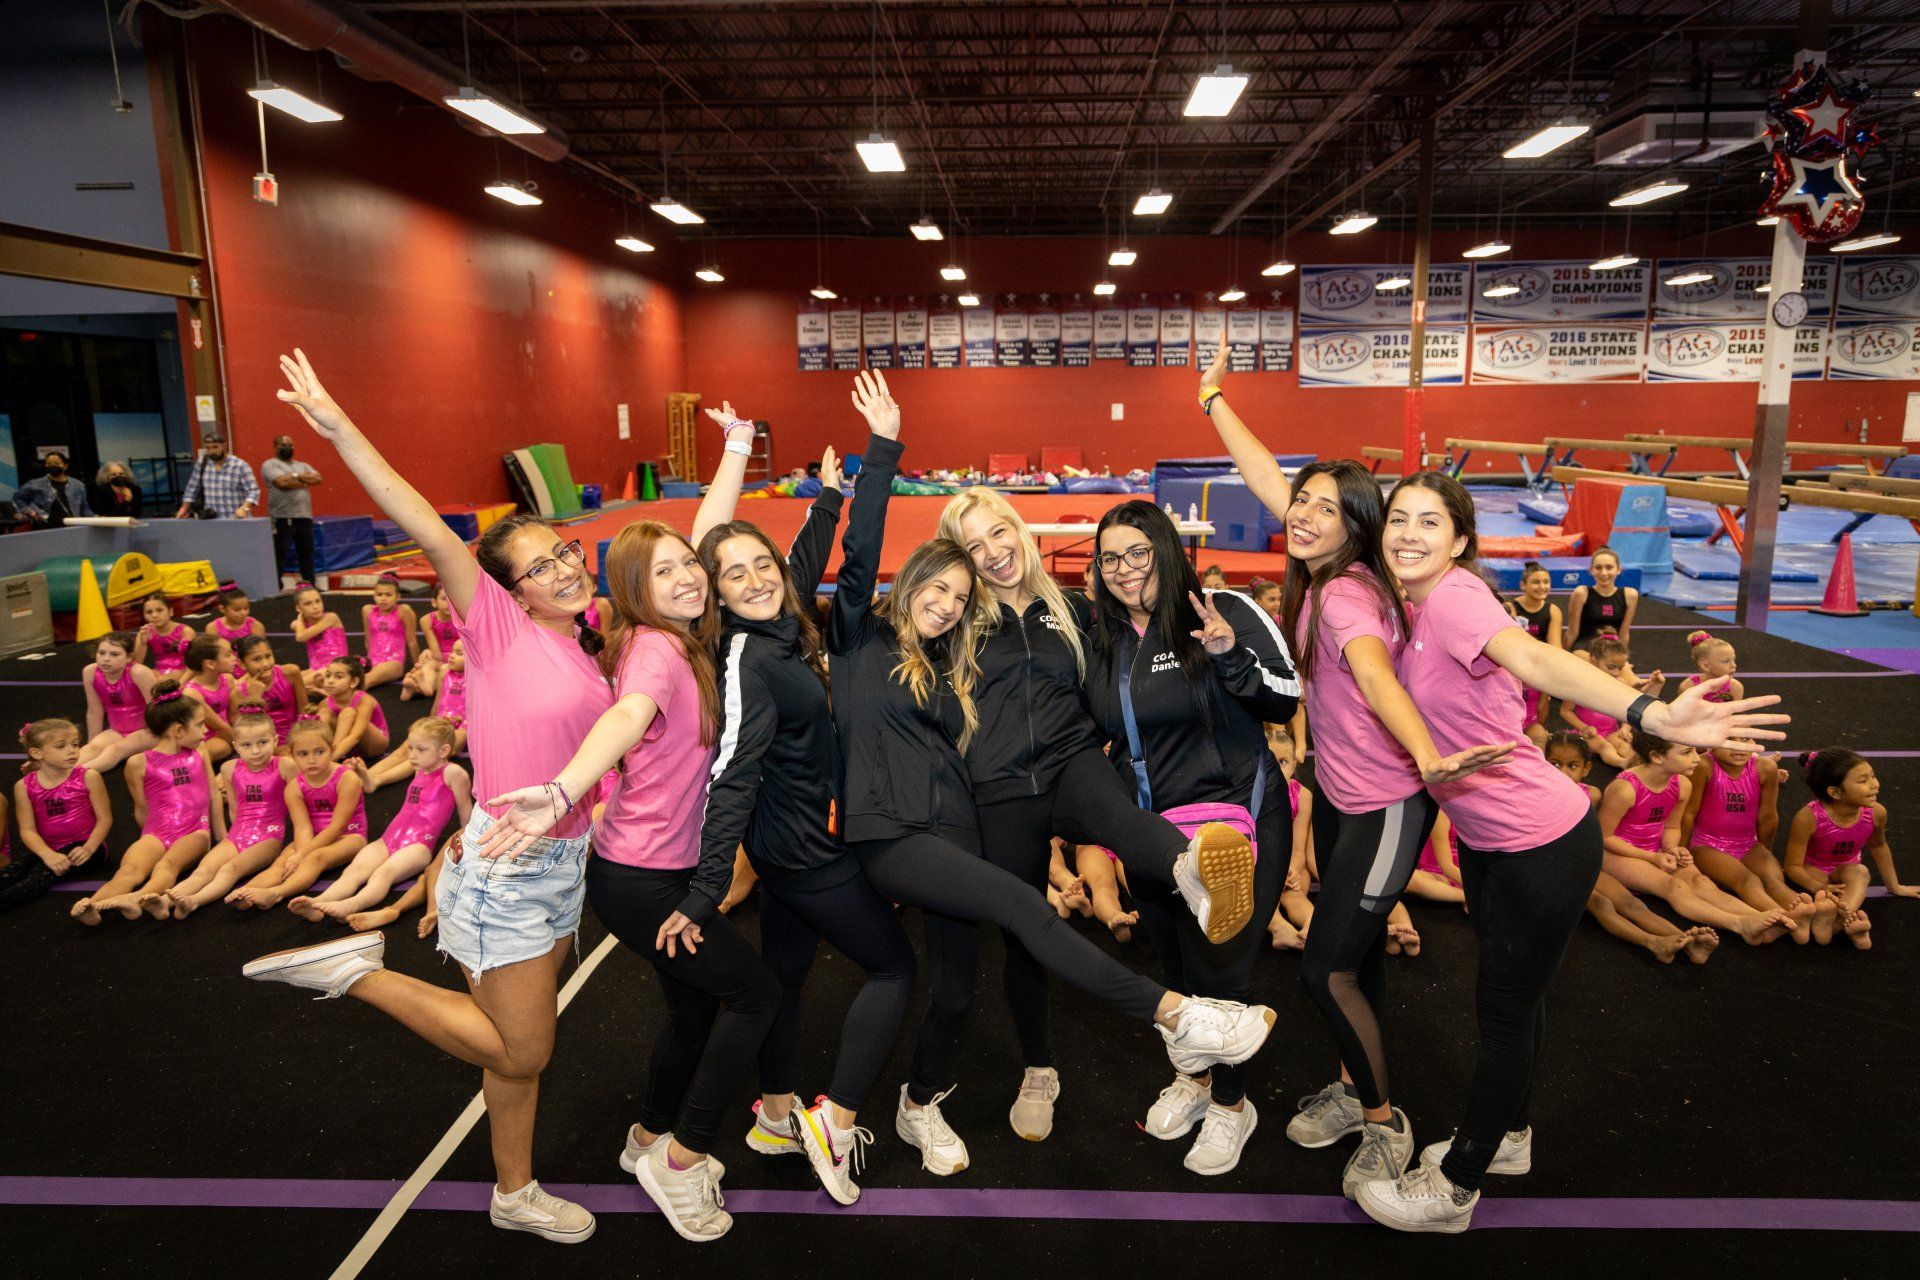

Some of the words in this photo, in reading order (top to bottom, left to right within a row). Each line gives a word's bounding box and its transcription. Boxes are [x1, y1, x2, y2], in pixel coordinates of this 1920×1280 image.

[1553, 268, 1590, 280] 2015
[1594, 268, 1643, 280] STATE
[1552, 282, 1643, 294] CHAMPIONS
[1869, 284, 1902, 295] USA
[1327, 294, 1358, 304] USA
[1570, 296, 1592, 304] Level
[1550, 331, 1586, 343] 2016
[1590, 332, 1637, 342] STATE
[1729, 329, 1766, 340] 2015
[1373, 335, 1410, 346] 2018
[1373, 349, 1459, 359] CHAMIONS
[1549, 345, 1637, 356] CHAMPIONS
[1862, 348, 1893, 358] USA
[1326, 356, 1356, 365] USA
[1501, 354, 1531, 363] USA
[1677, 351, 1709, 361] USA
[1569, 358, 1586, 366] Level
[1151, 660, 1181, 673] Danie
[170, 766, 189, 776] TAG
[173, 776, 191, 786] USA
[245, 784, 262, 794] TAG
[1725, 793, 1745, 803] TAG
[1725, 803, 1746, 813] USA
